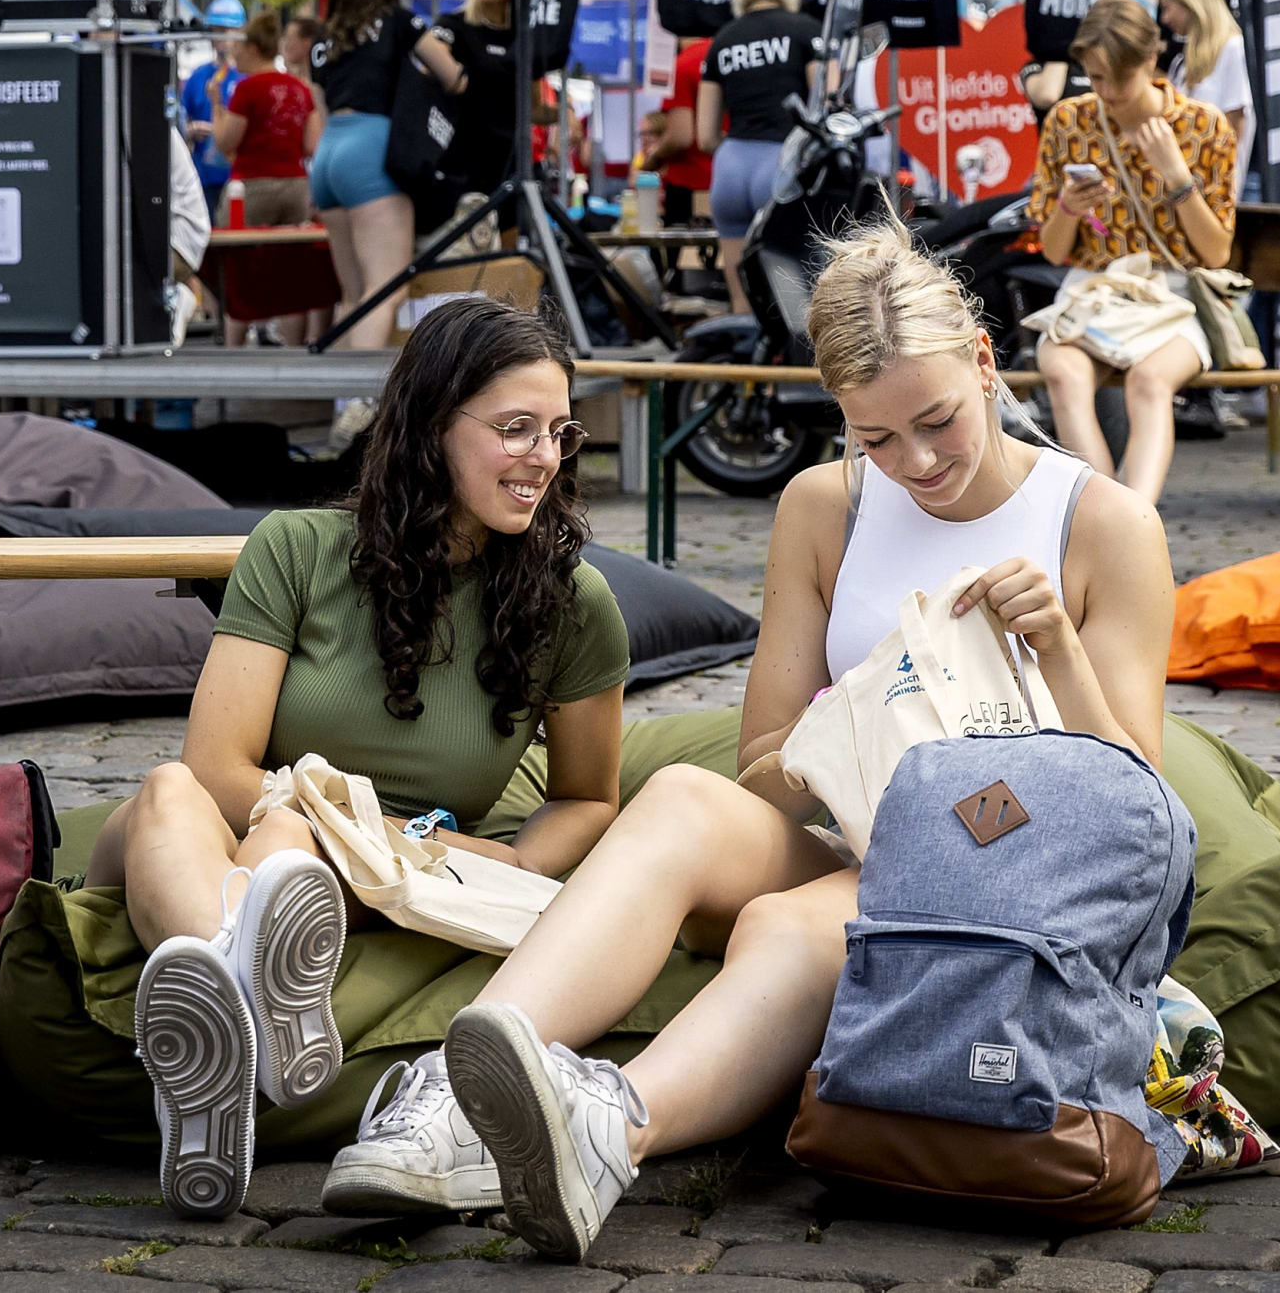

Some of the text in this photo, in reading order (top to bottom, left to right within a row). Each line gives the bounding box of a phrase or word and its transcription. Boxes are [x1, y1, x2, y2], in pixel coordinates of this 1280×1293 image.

[718, 36, 790, 75] CREW
[898, 75, 936, 105] Uit
[944, 70, 1008, 102] iefde
